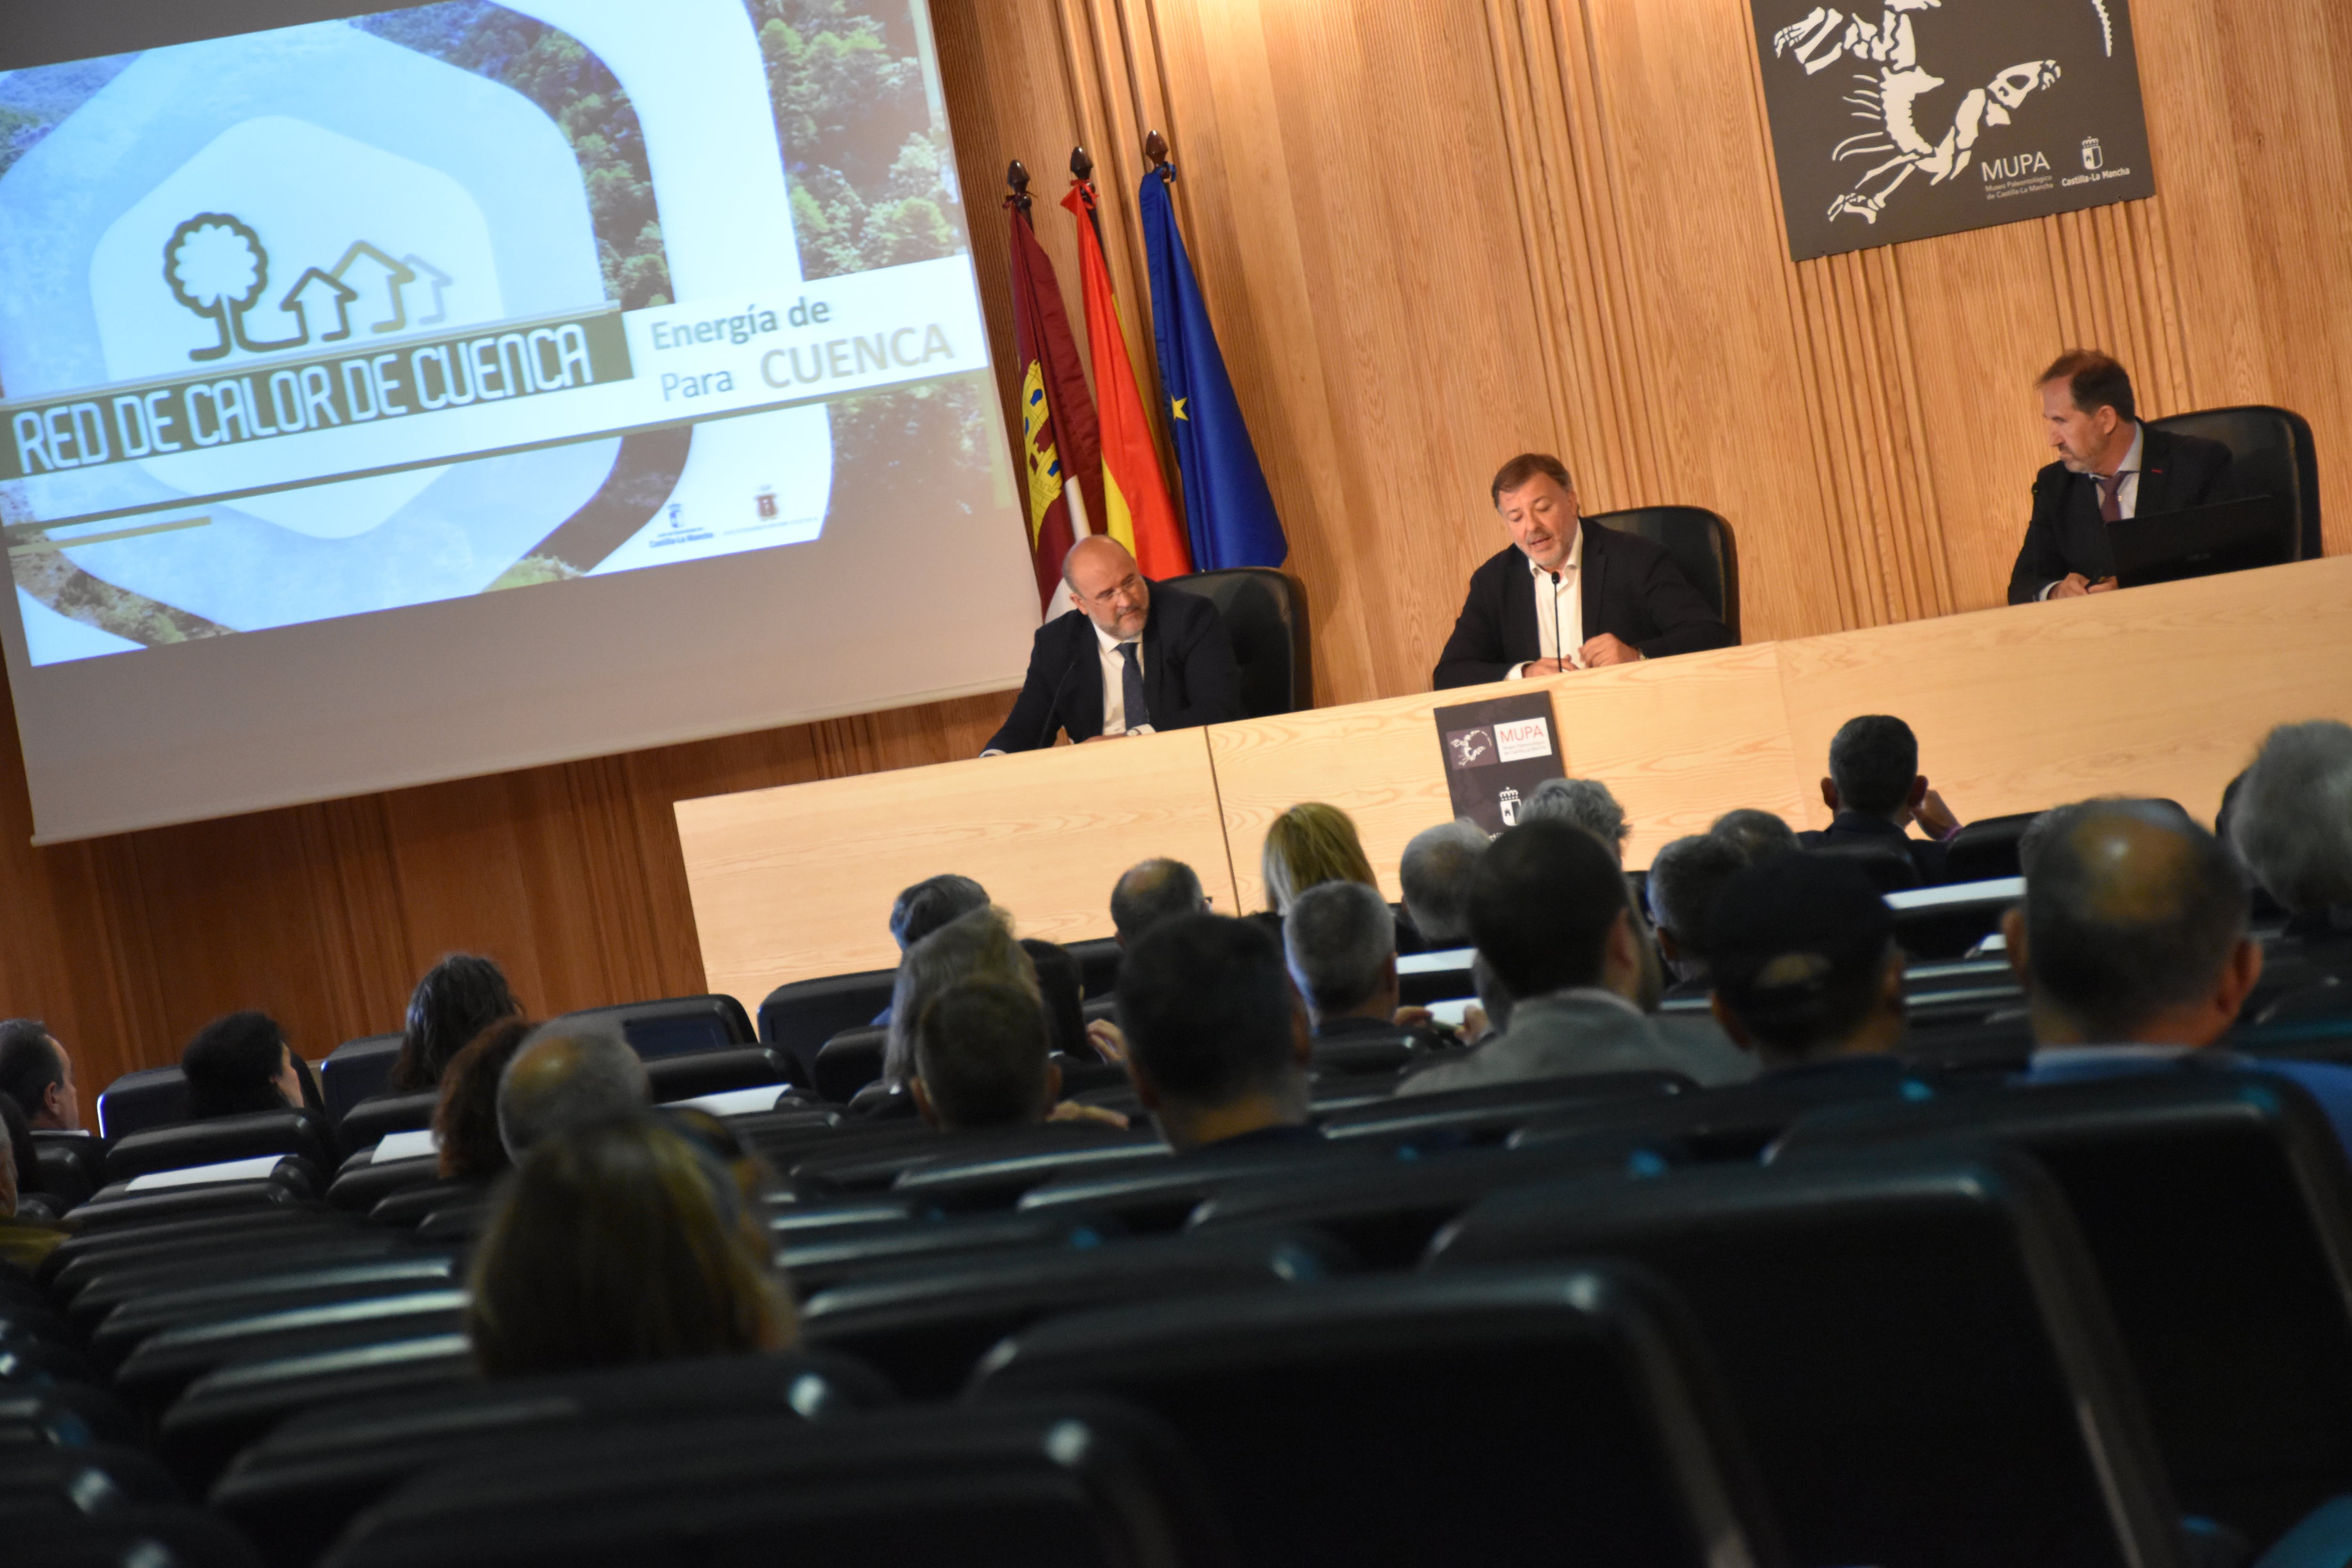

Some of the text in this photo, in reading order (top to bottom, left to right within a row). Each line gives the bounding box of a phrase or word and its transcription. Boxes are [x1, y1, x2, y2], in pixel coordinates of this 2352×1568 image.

[1981, 151, 2051, 182] MUPA
[2062, 168, 2130, 186] Castilla-La Mancha
[650, 295, 830, 350] Energía de
[661, 323, 955, 401] Para CUENCA
[12, 323, 594, 474] RED DE CALOR DE CUENCA
[1500, 725, 1544, 743] MUPA
